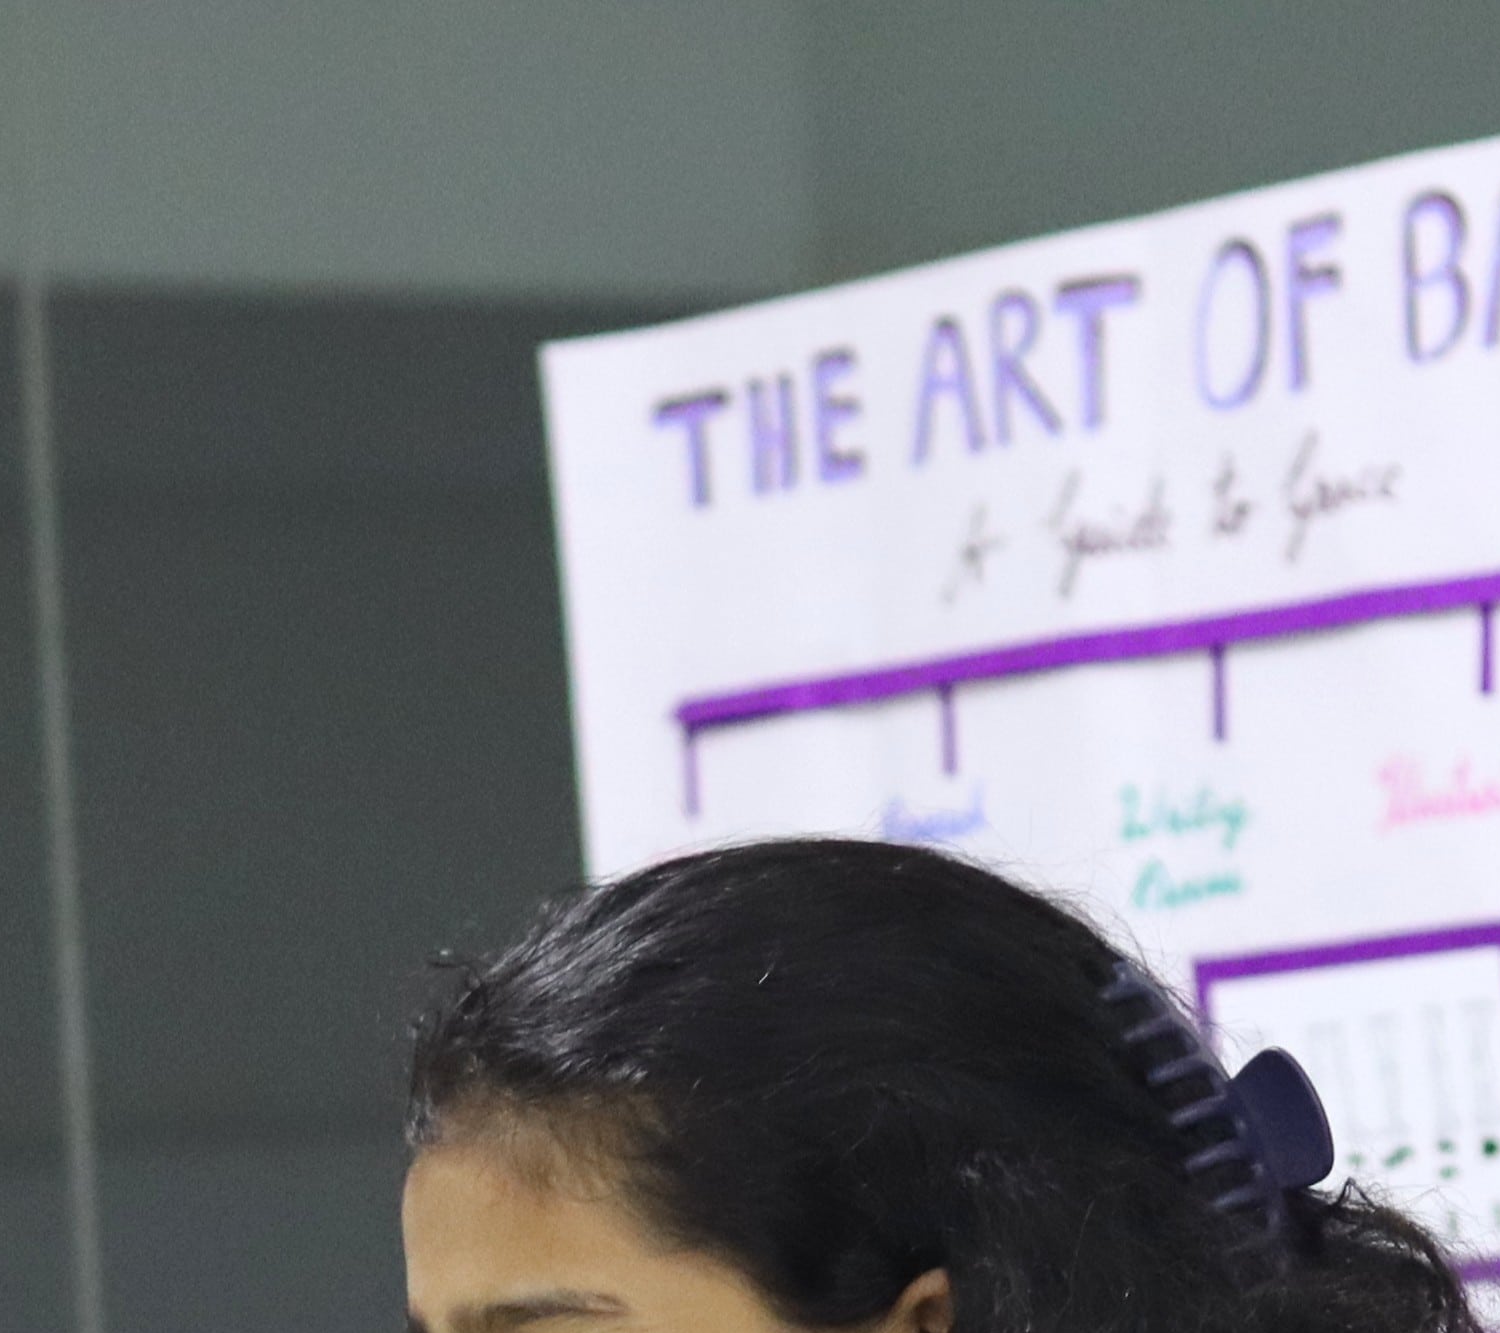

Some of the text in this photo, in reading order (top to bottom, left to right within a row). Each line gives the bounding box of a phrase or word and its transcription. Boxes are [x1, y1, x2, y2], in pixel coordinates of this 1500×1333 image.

[653, 350, 864, 507] THE
[913, 273, 1141, 466] ART
[1201, 210, 1343, 411] OF
